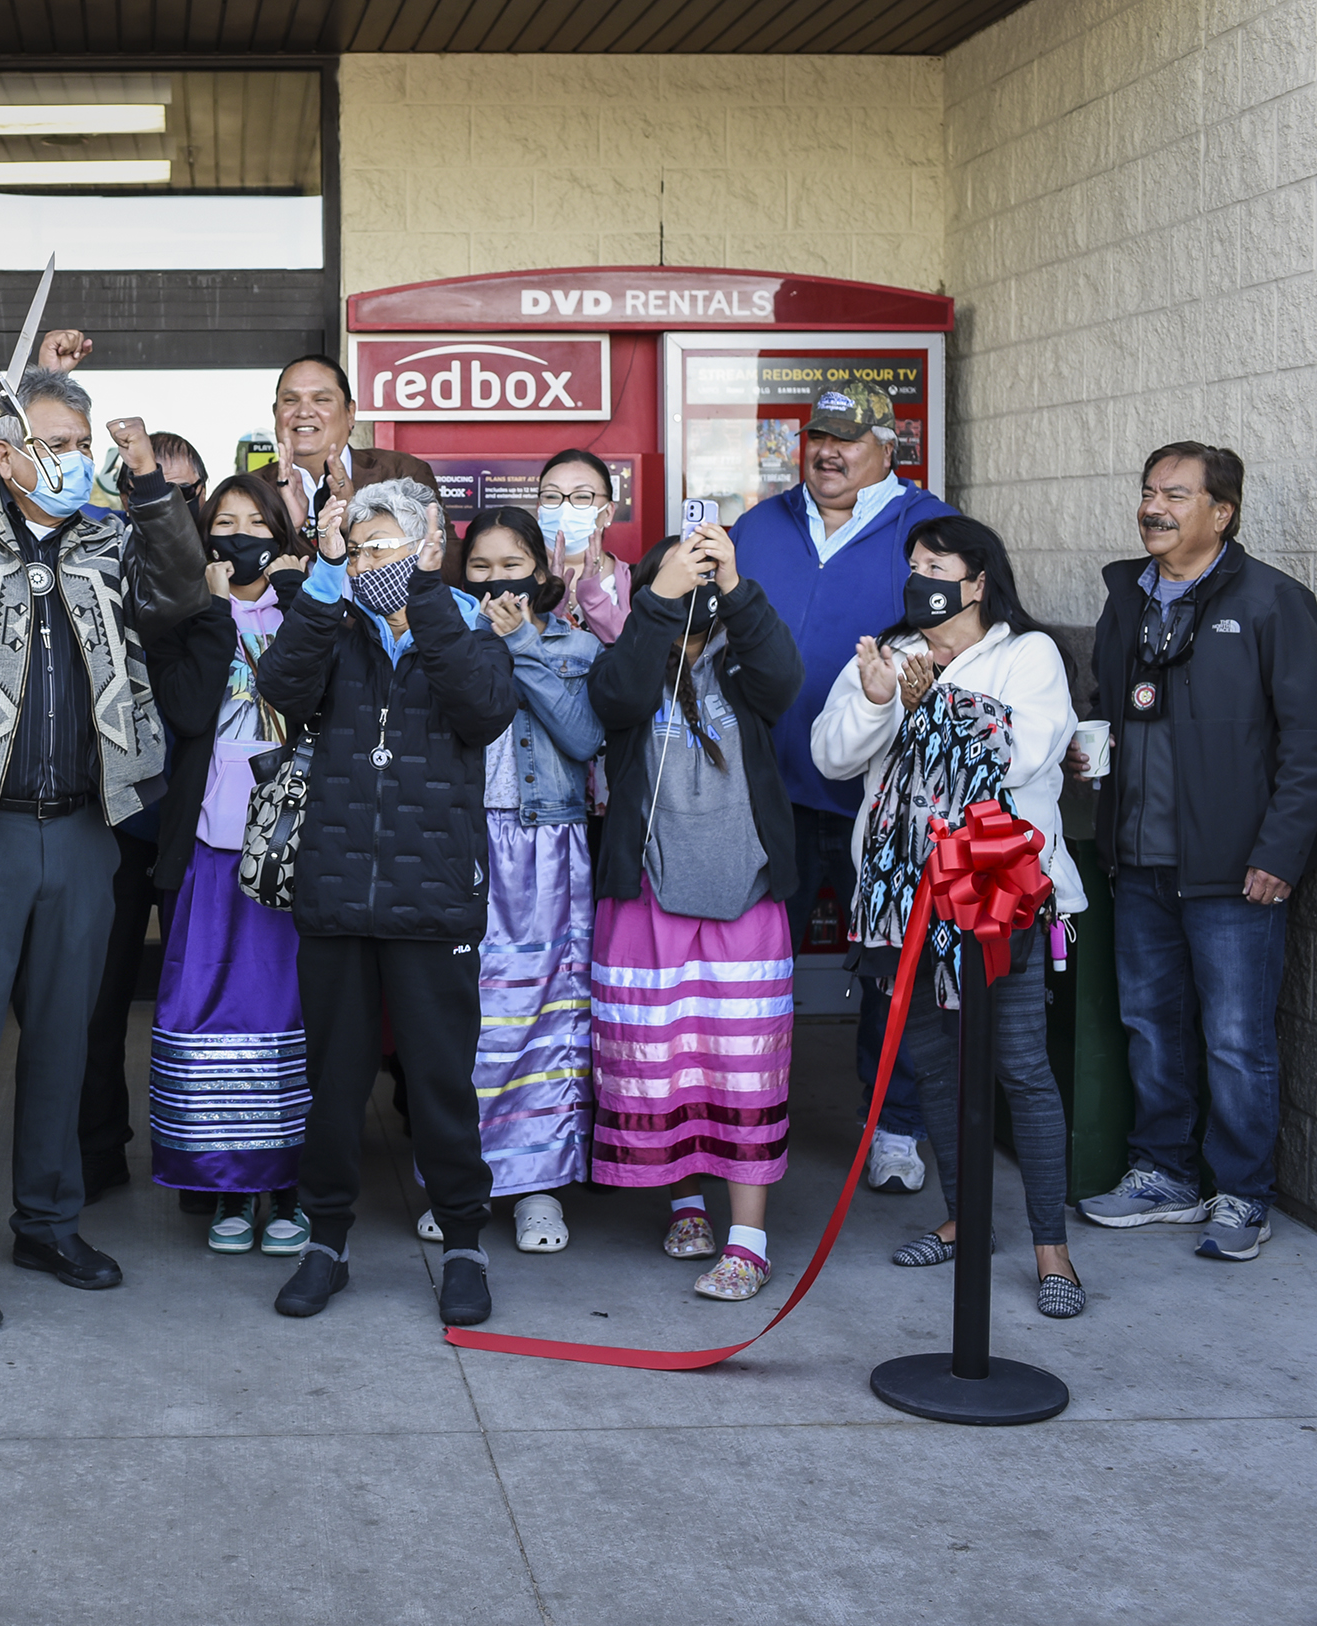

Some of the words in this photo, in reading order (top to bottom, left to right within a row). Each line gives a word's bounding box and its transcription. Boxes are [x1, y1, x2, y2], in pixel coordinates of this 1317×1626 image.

[521, 290, 612, 315] DVD
[625, 290, 773, 316] RENTALS
[373, 360, 576, 408] redbox
[698, 368, 758, 381] STREAM
[762, 369, 823, 381] REDBOX
[826, 369, 850, 381] ON
[853, 368, 894, 381] YOUR
[898, 368, 918, 381] TV
[453, 944, 471, 955] FILA
